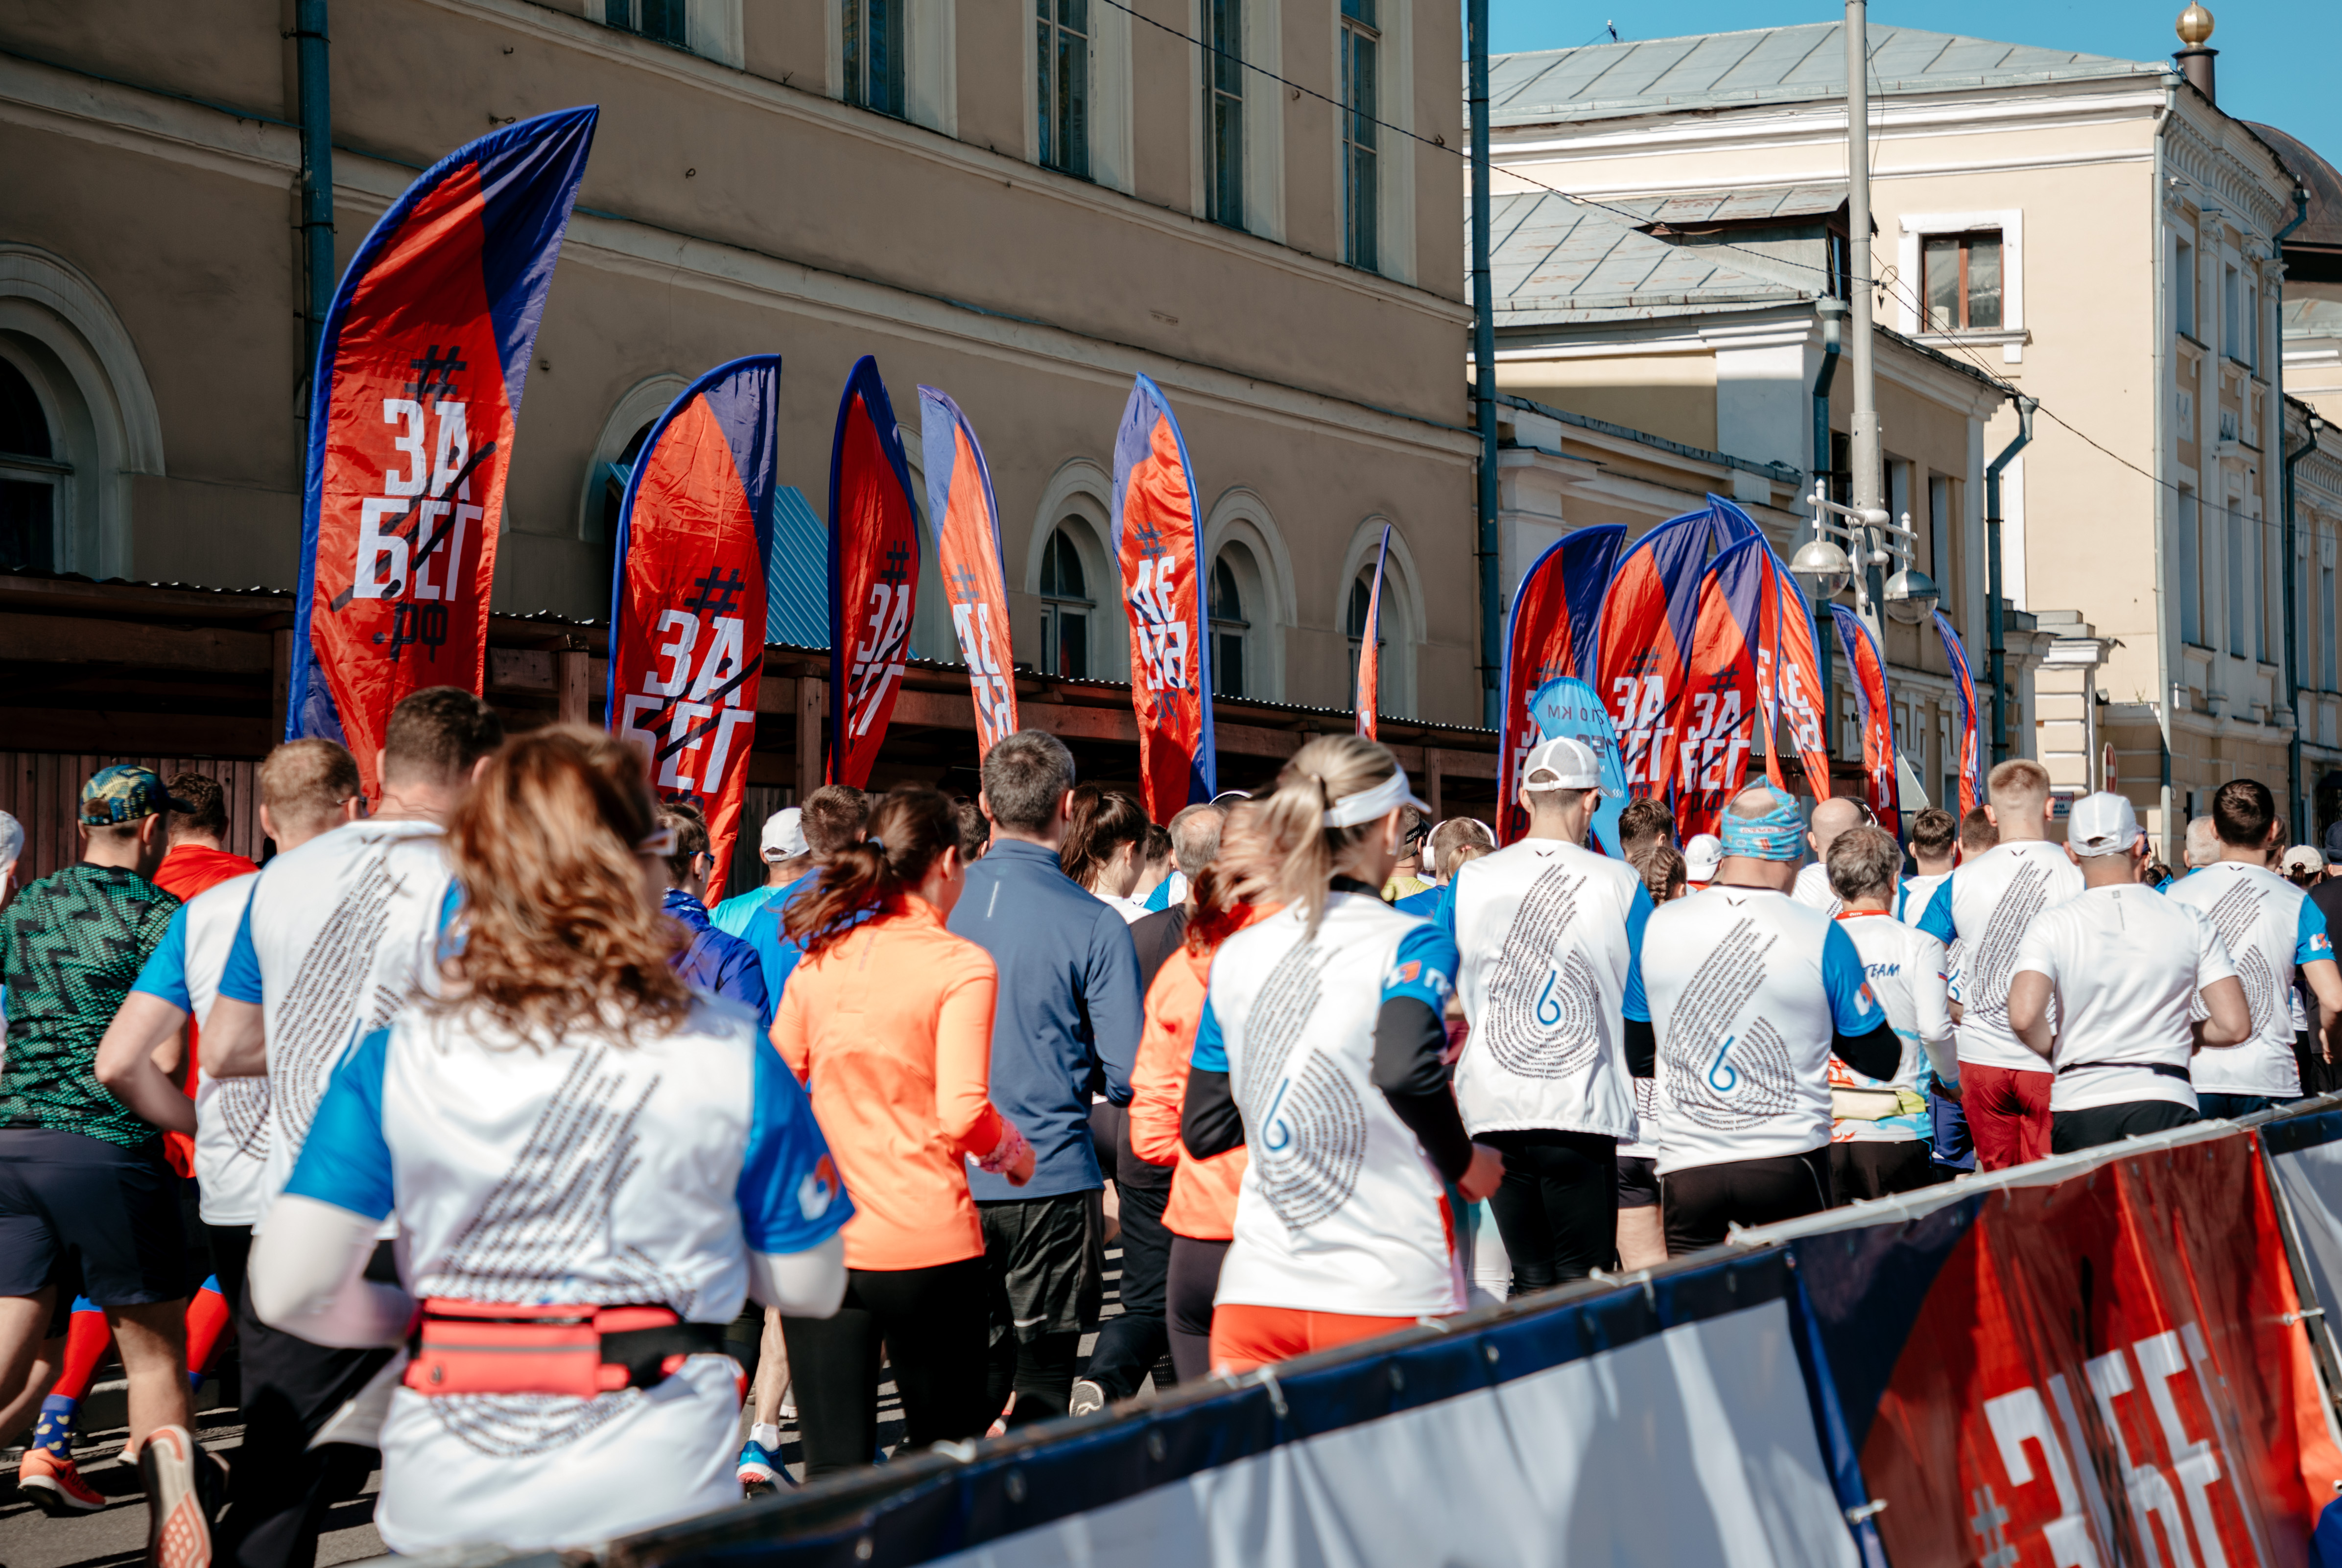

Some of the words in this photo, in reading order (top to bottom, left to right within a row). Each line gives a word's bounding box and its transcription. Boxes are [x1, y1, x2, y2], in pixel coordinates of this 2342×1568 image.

[383, 398, 471, 500] ЗА
[352, 497, 483, 601] БЕГ
[856, 583, 910, 662] ЗА
[642, 609, 744, 708] ЗА
[1611, 675, 1666, 730] ЗА
[1687, 690, 1741, 741] ЗА
[1680, 739, 1751, 794] БЕГ
[1514, 903, 1533, 940] КАЛИНИНГРАД
[1531, 885, 1544, 902] КАЛУГА
[1543, 864, 1564, 885] КЕМЕРОВО
[1520, 922, 1530, 944] МАЙКОП
[1529, 892, 1547, 921] МАХАЧКАЛА
[1546, 875, 1562, 891] МОСКВА
[1540, 909, 1553, 927] РЯЗАНЬ
[1552, 890, 1566, 908] САМАРА
[1550, 886, 1561, 898] ОМСК
[1553, 901, 1565, 918] СУРГУТ
[1564, 876, 1587, 902] СЫКТЫВКАР
[1555, 901, 1576, 928] ЧЕБОКСАРЫ
[1500, 923, 1516, 960] ВЛАДИВОСТОК
[1514, 887, 1535, 923] ВЛАДИКАВКАЗ
[1557, 911, 1577, 937] ЯРОСЛАВЛЬ
[1672, 979, 1696, 1016] ВЛАДИВОСТОК
[1694, 944, 1723, 979] ВЛАДИКАВКАЗ
[1680, 998, 1692, 1017] КАЗАНЬ
[1690, 961, 1719, 997] КАЛИНИНГРАД
[1717, 944, 1732, 961] КАЛУГА
[1685, 1000, 1708, 1036] НОВОСИБИРСК
[1738, 946, 1750, 960] ОМСК
[1697, 981, 1713, 1002] МАЙКОП
[1712, 952, 1736, 981] МАХАЧКАЛА
[1725, 970, 1741, 989] РЯЗАНЬ
[1740, 951, 1756, 970] САМАРА
[1700, 1013, 1718, 1039] СМОЛЕНСК
[1716, 982, 1741, 1013] СТАВРОПОЛЬ
[1740, 963, 1754, 981] СУРГУТ
[1713, 1021, 1722, 1031] УФА
[1721, 992, 1743, 1021] ХАБАРОВСК
[1730, 1002, 1745, 1021] ЯКУТСК
